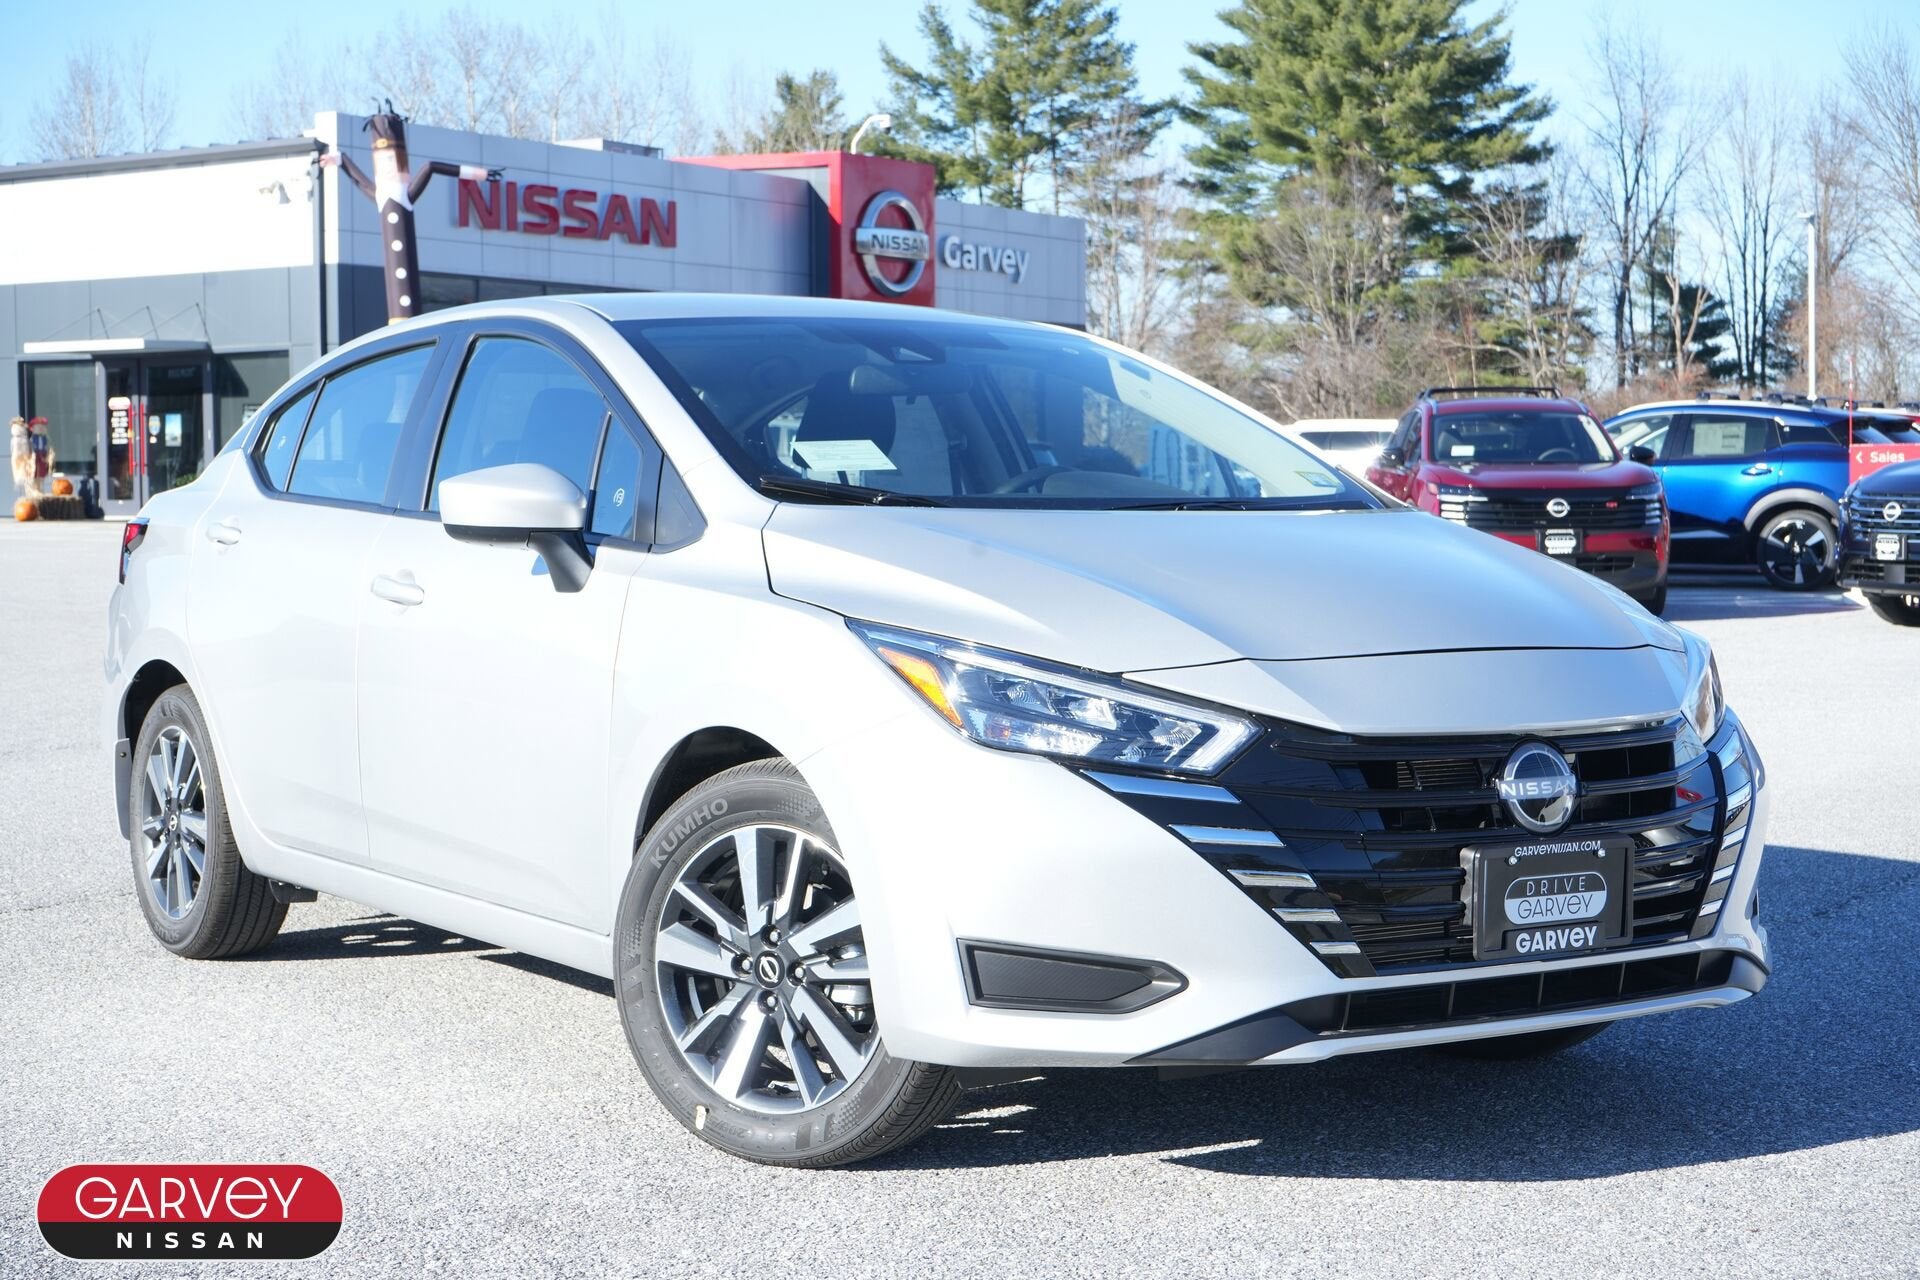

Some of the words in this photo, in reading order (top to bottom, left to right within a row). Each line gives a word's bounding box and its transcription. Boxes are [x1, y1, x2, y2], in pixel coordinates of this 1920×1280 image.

[458, 177, 677, 248] NISSAN
[871, 233, 927, 251] NISSAN
[943, 235, 1029, 284] Garvey
[1870, 451, 1905, 463] Sales
[1501, 779, 1576, 797] NISSAN
[650, 798, 728, 869] KUMHO
[1514, 840, 1602, 858] GARVEYNISSAN.COM
[1526, 876, 1587, 896] DRIVE
[1517, 894, 1593, 920] GARVEY
[1515, 926, 1598, 954] GARVEY
